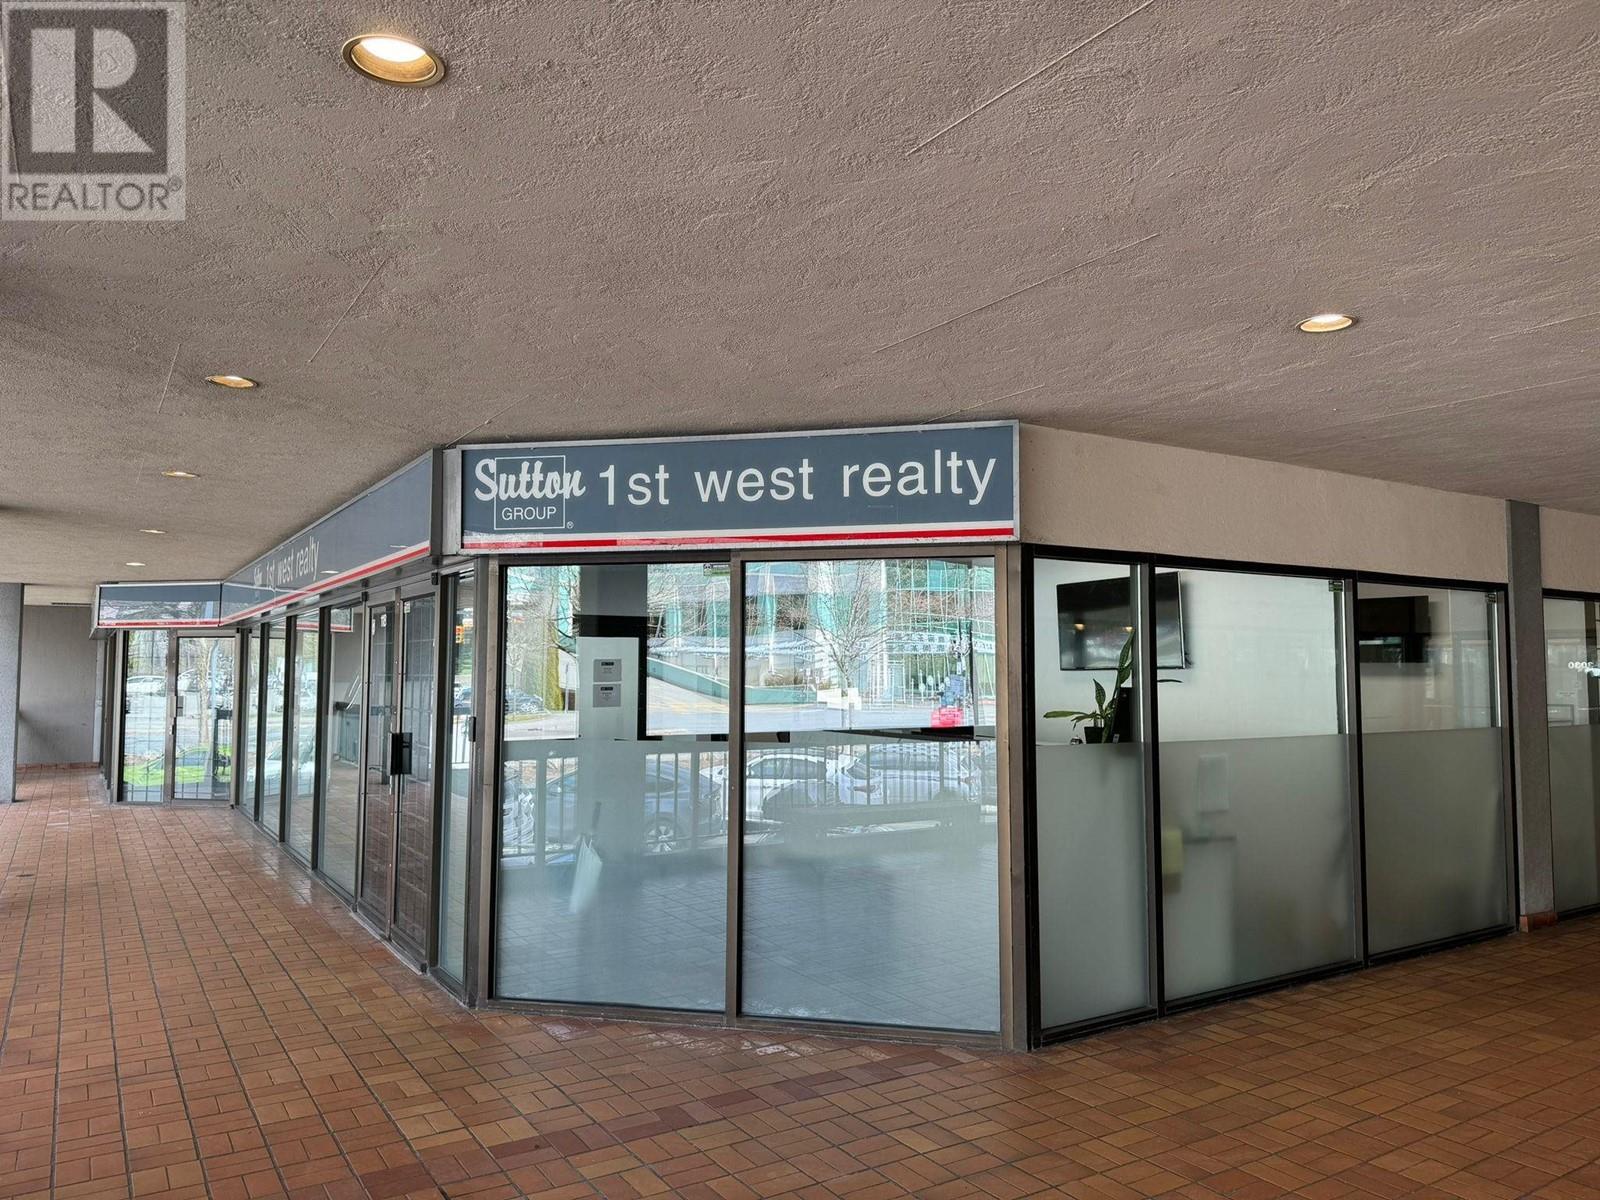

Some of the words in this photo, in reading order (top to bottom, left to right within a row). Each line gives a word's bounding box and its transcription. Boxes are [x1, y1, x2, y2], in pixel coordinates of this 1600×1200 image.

[474, 458, 586, 501] Sutton
[599, 464, 670, 506] 1st
[694, 458, 814, 503] west
[843, 449, 997, 507] realty
[501, 506, 557, 520] GROUP
[277, 548, 294, 586] west
[295, 535, 320, 582] realty
